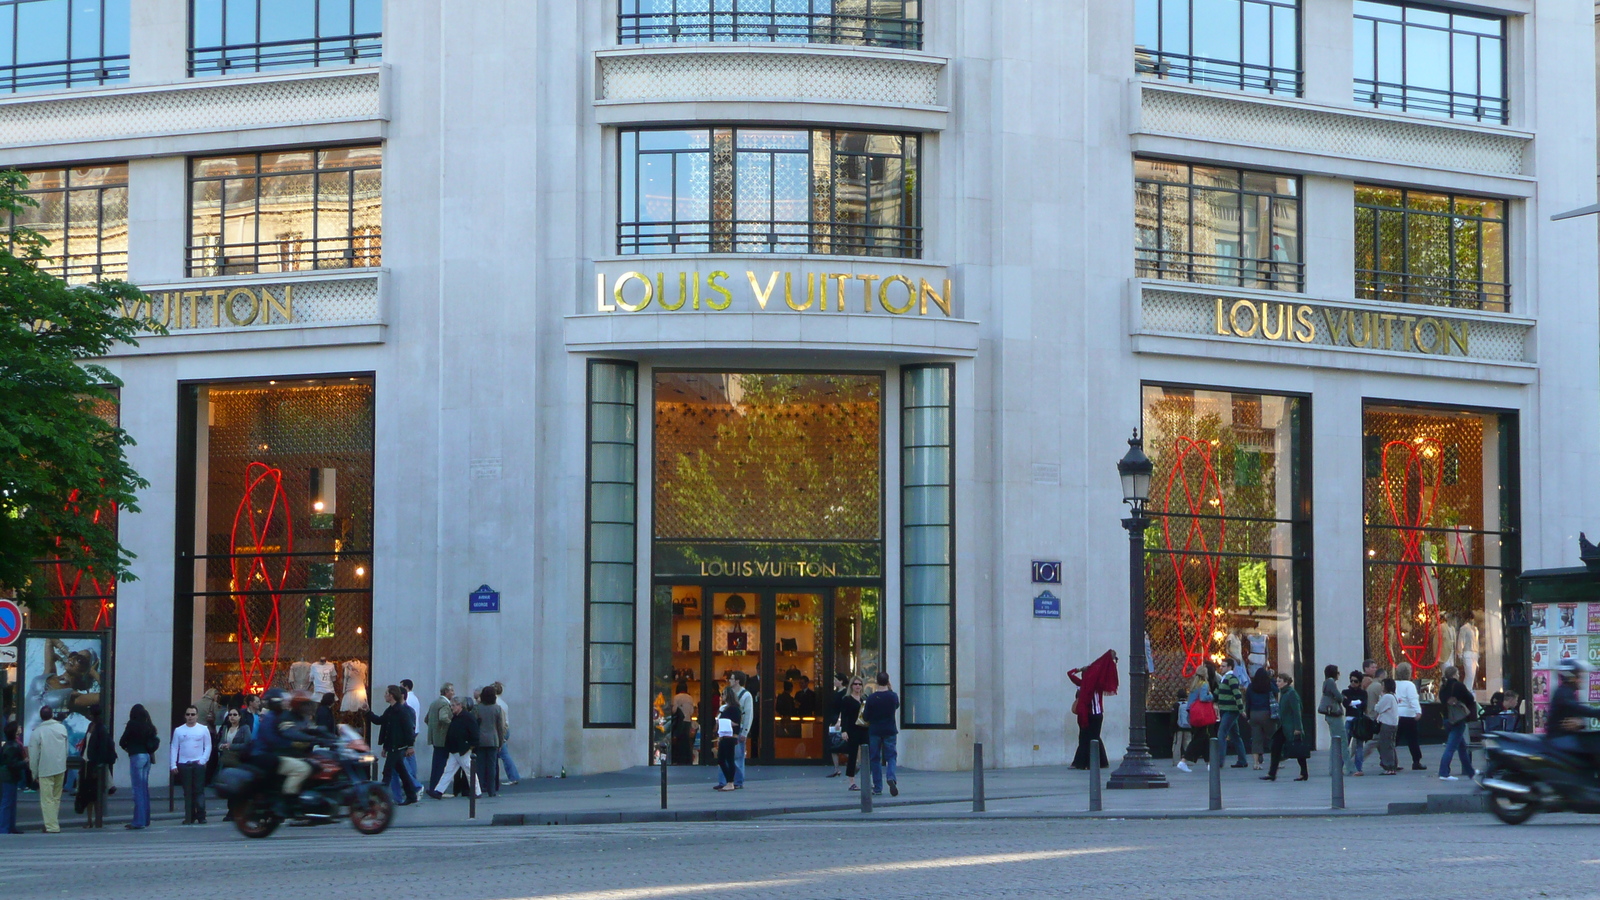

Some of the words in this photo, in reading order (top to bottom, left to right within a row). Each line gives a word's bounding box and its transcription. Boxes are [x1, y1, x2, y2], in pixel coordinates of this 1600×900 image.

[113, 284, 293, 330] VUITTON
[597, 269, 733, 312] LOUIS
[745, 269, 951, 317] VUITTON
[1216, 297, 1316, 343] LOUIS
[1323, 307, 1468, 357] VUITTON
[700, 561, 753, 577] LOUIS
[756, 561, 837, 578] VUITTON
[1034, 563, 1060, 582] 101
